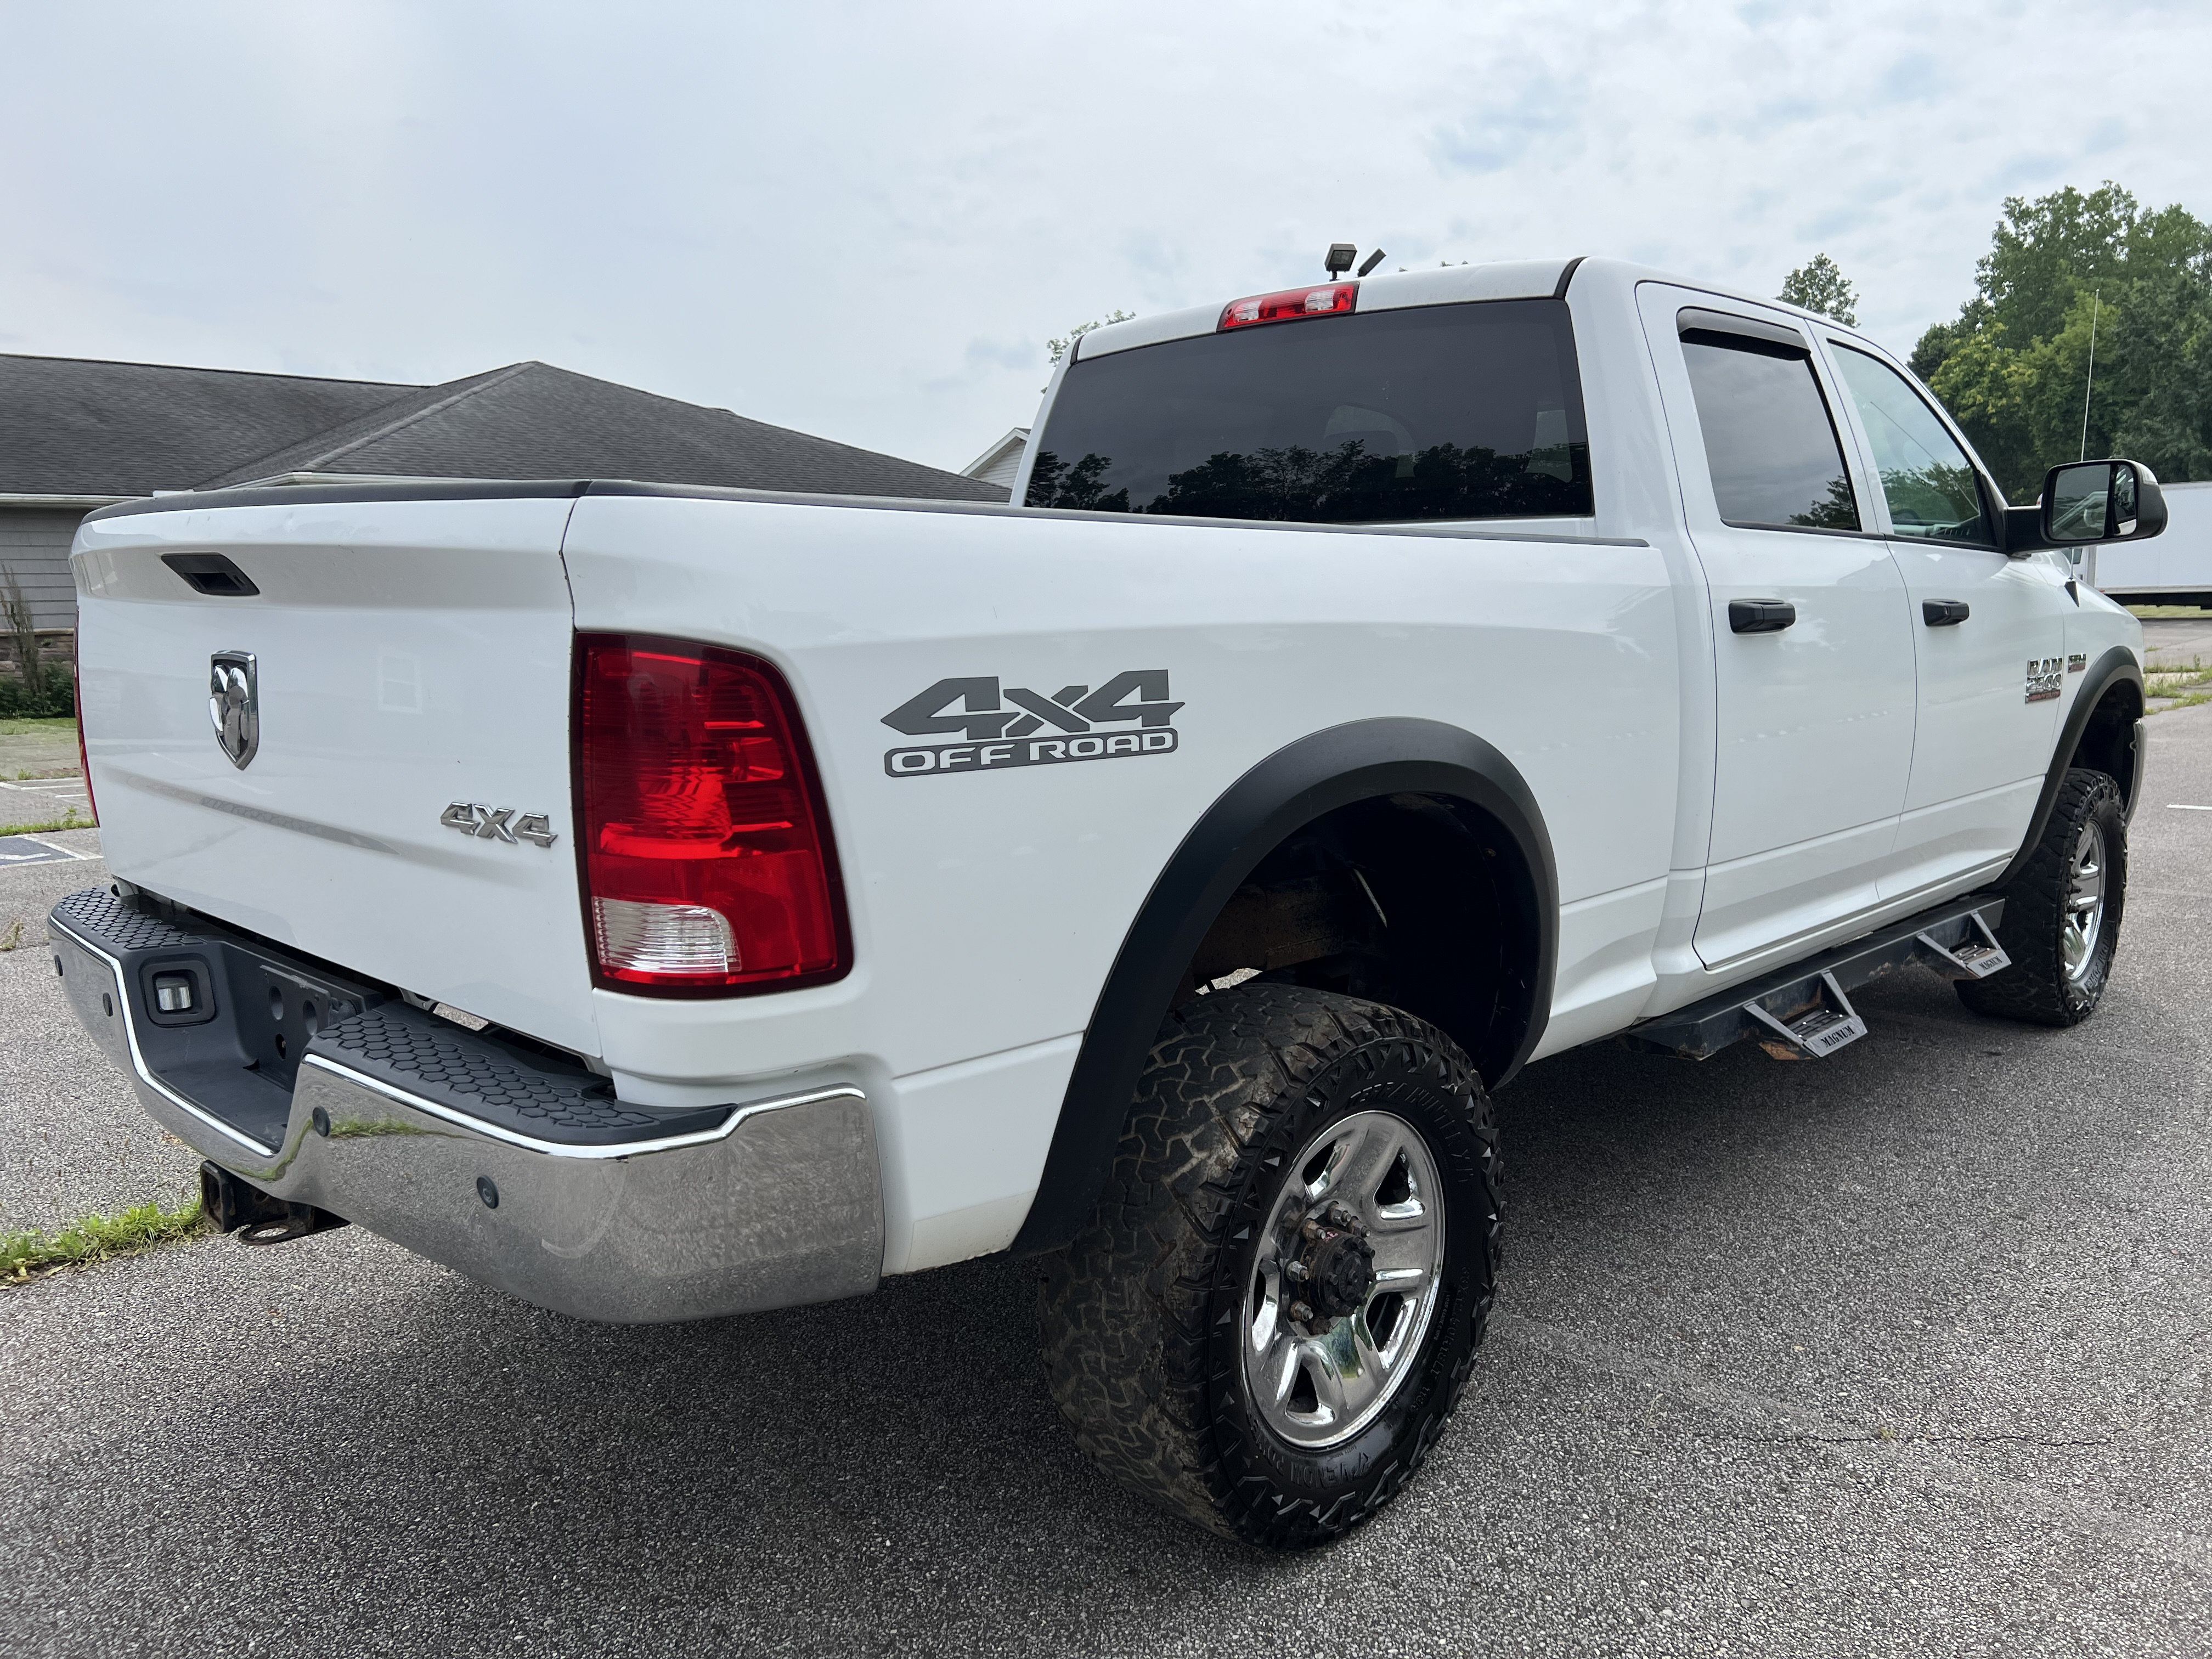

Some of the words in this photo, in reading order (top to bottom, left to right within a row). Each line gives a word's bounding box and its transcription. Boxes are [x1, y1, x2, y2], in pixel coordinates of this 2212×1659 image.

[891, 743, 1018, 772] OFF
[1029, 732, 1174, 761] ROAD
[1820, 1025, 1855, 1048] MAGNUM
